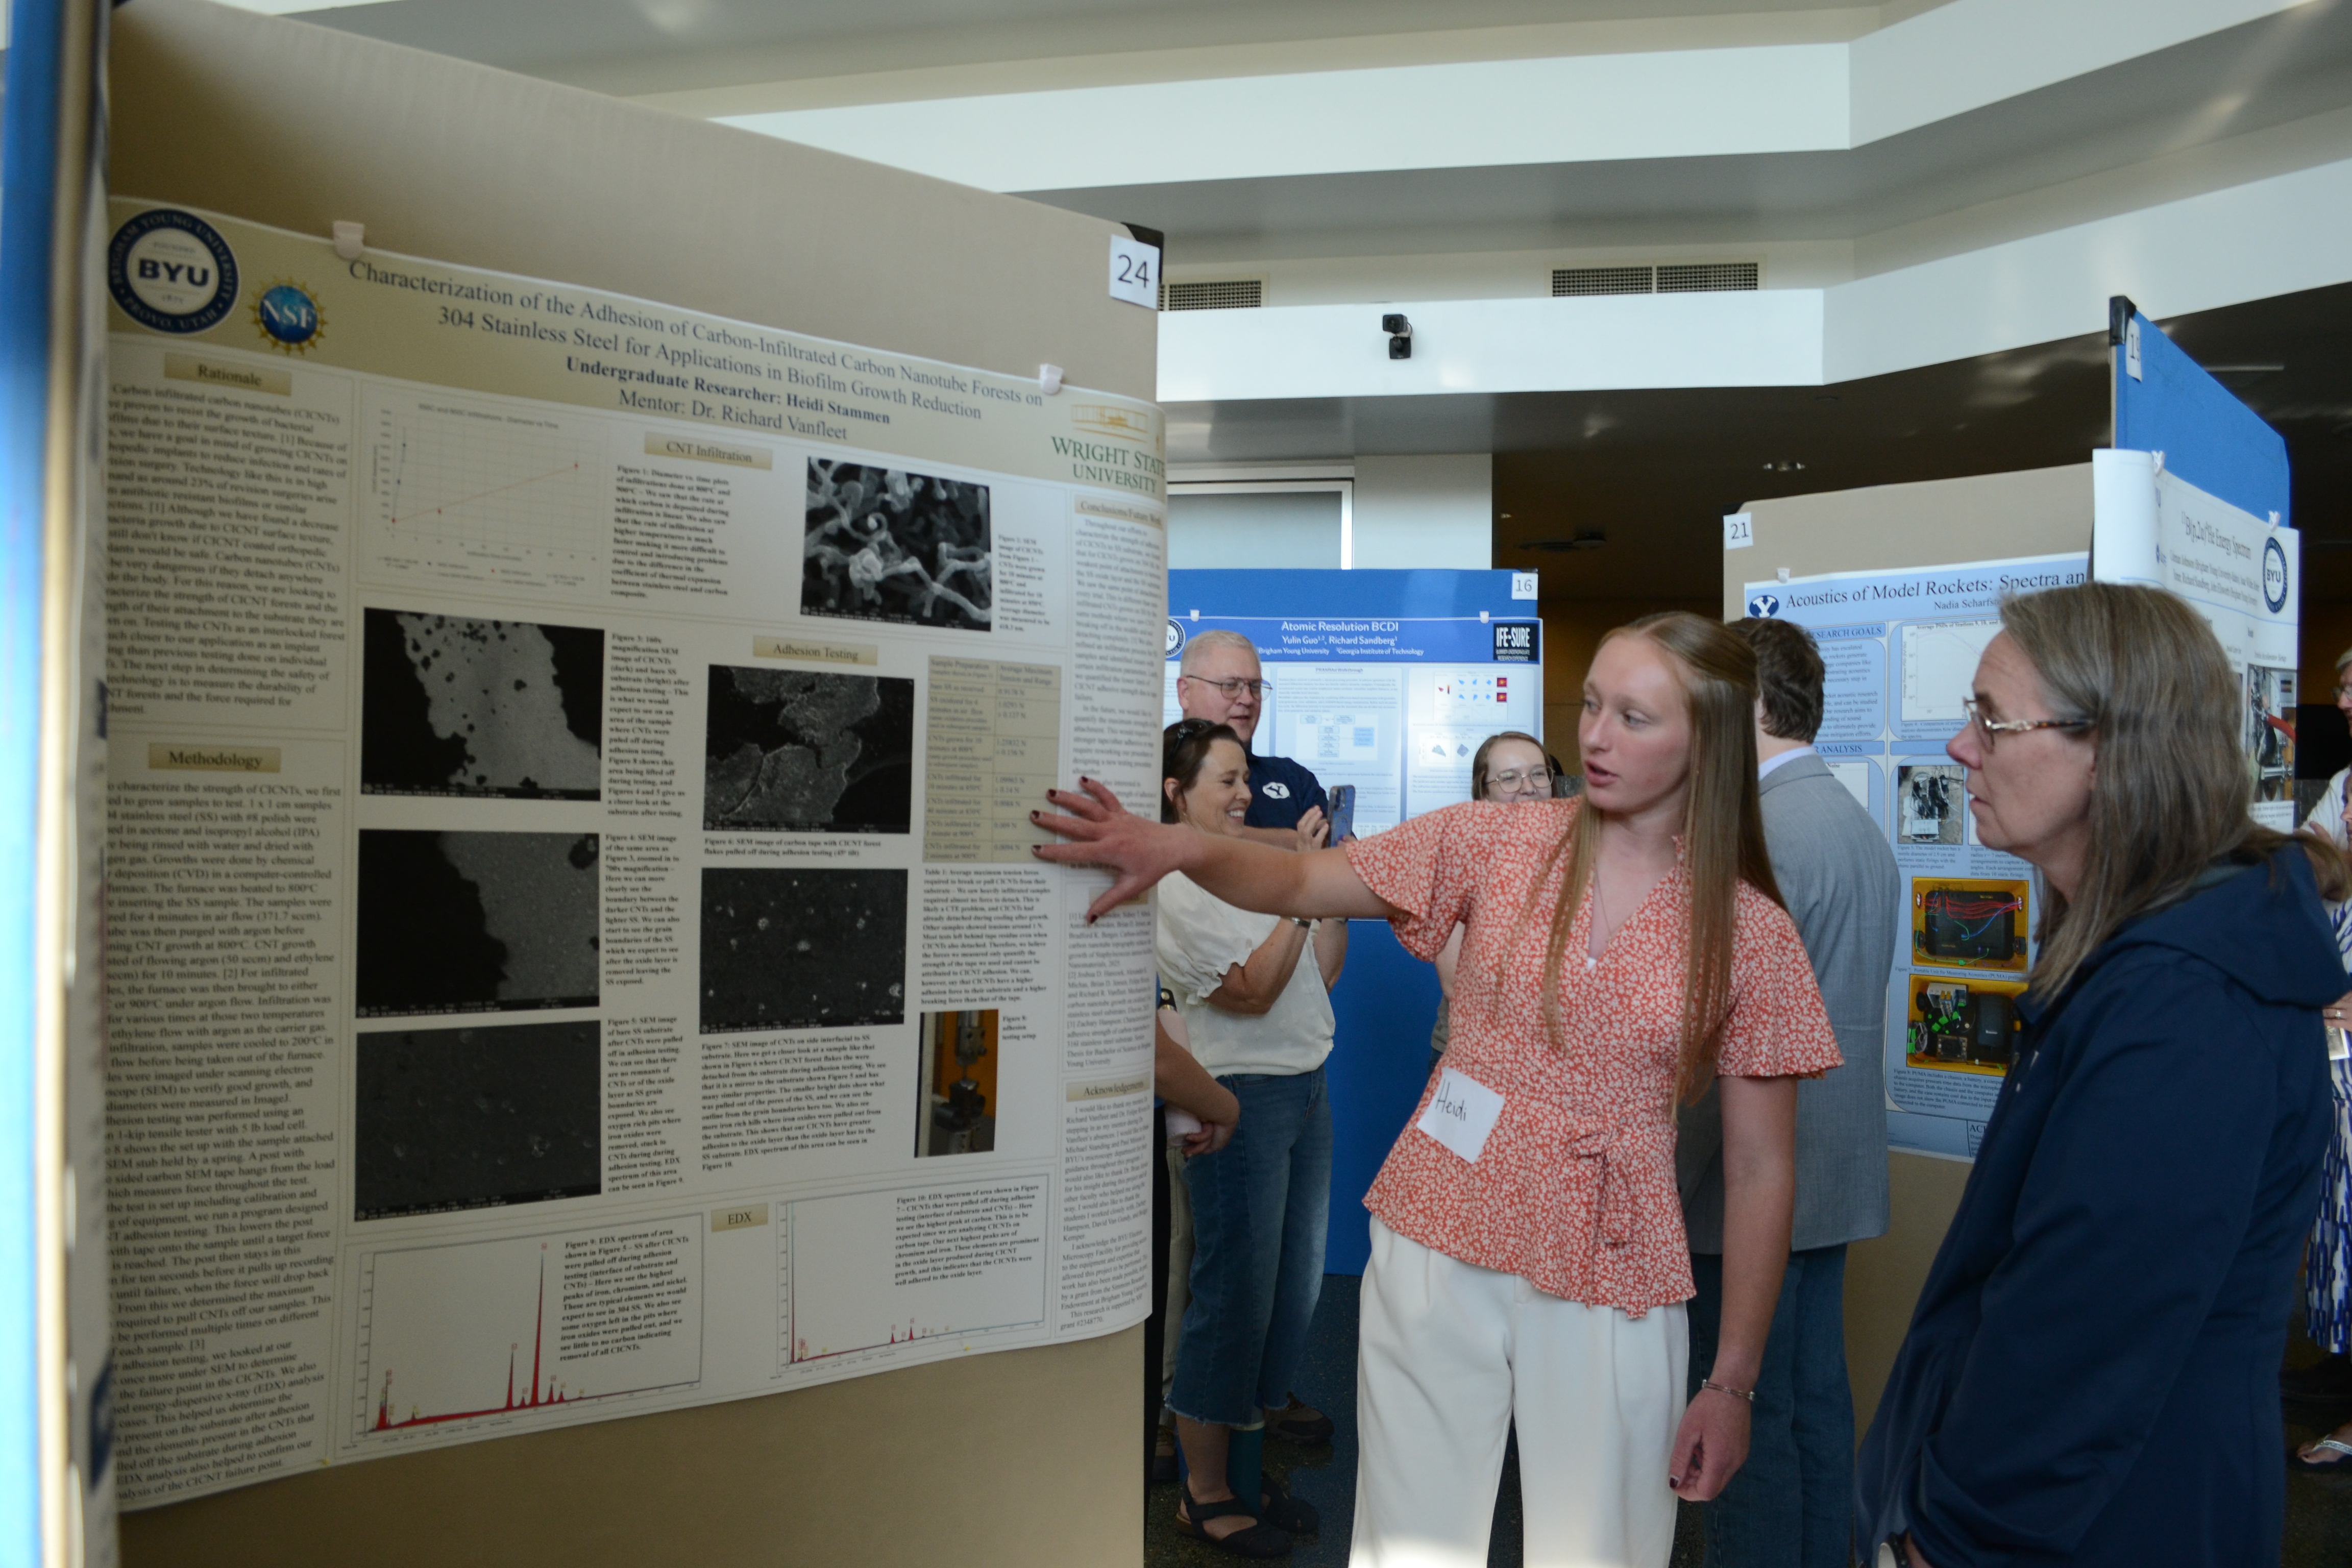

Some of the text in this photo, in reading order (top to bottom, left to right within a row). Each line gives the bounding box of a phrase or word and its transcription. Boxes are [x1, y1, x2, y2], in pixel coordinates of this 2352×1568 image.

[138, 258, 210, 288] BYU
[1118, 254, 1149, 288] 24
[262, 299, 316, 328] NSF
[348, 259, 1042, 406] Characterization of the Adhesion of Carbon-Infiltrated Carbon Nanotube Forests on
[437, 306, 981, 419] 304 Stainless Steel for Applications in Biofilm Growth Reduction
[197, 364, 263, 387] Rationale
[567, 357, 890, 423] Undergraduate Researcher: Heidi Stammen
[619, 389, 847, 439] Mentor: Dr. Richard Vanfleet
[665, 442, 752, 463] CNT Infiltration
[1050, 435, 1130, 466] WRIGHT
[1072, 463, 1157, 494] UNIVERSITY
[1729, 521, 1750, 541] 21
[1515, 578, 1533, 593] 16
[2266, 568, 2282, 584] BYU
[1786, 570, 2086, 609] Acoustics of Model Rockets: Spectra an
[1933, 599, 1959, 612] Nadia
[1281, 621, 1400, 632] Atomic Resolution BCDI
[1814, 625, 1883, 639] SEARCH GOALS
[1281, 635, 1302, 645] Yulin
[1329, 635, 1358, 645] Richard
[1496, 626, 1531, 648] IFE-SURE
[774, 644, 860, 662] Adhesion Testing
[1282, 647, 1302, 656] Young
[1302, 647, 1330, 656] University
[1360, 647, 1383, 655] Institute
[1383, 647, 1391, 655] of
[1392, 647, 1425, 656] Technology
[1830, 731, 1855, 739] mitigation
[1857, 722, 1876, 730] provide
[1820, 744, 1863, 754] ANALYSIS
[168, 751, 264, 771] Methodology
[1435, 1078, 1467, 1122] Heidi
[106, 1147, 305, 1169] SEM stub held by a spring. A post with
[727, 1211, 751, 1225] EDX
[1070, 1310, 1083, 1318] This
[1083, 1305, 1106, 1316] research
[1060, 1321, 1076, 1332] grant
[121, 1341, 292, 1370] adhesion testing, we looked at our
